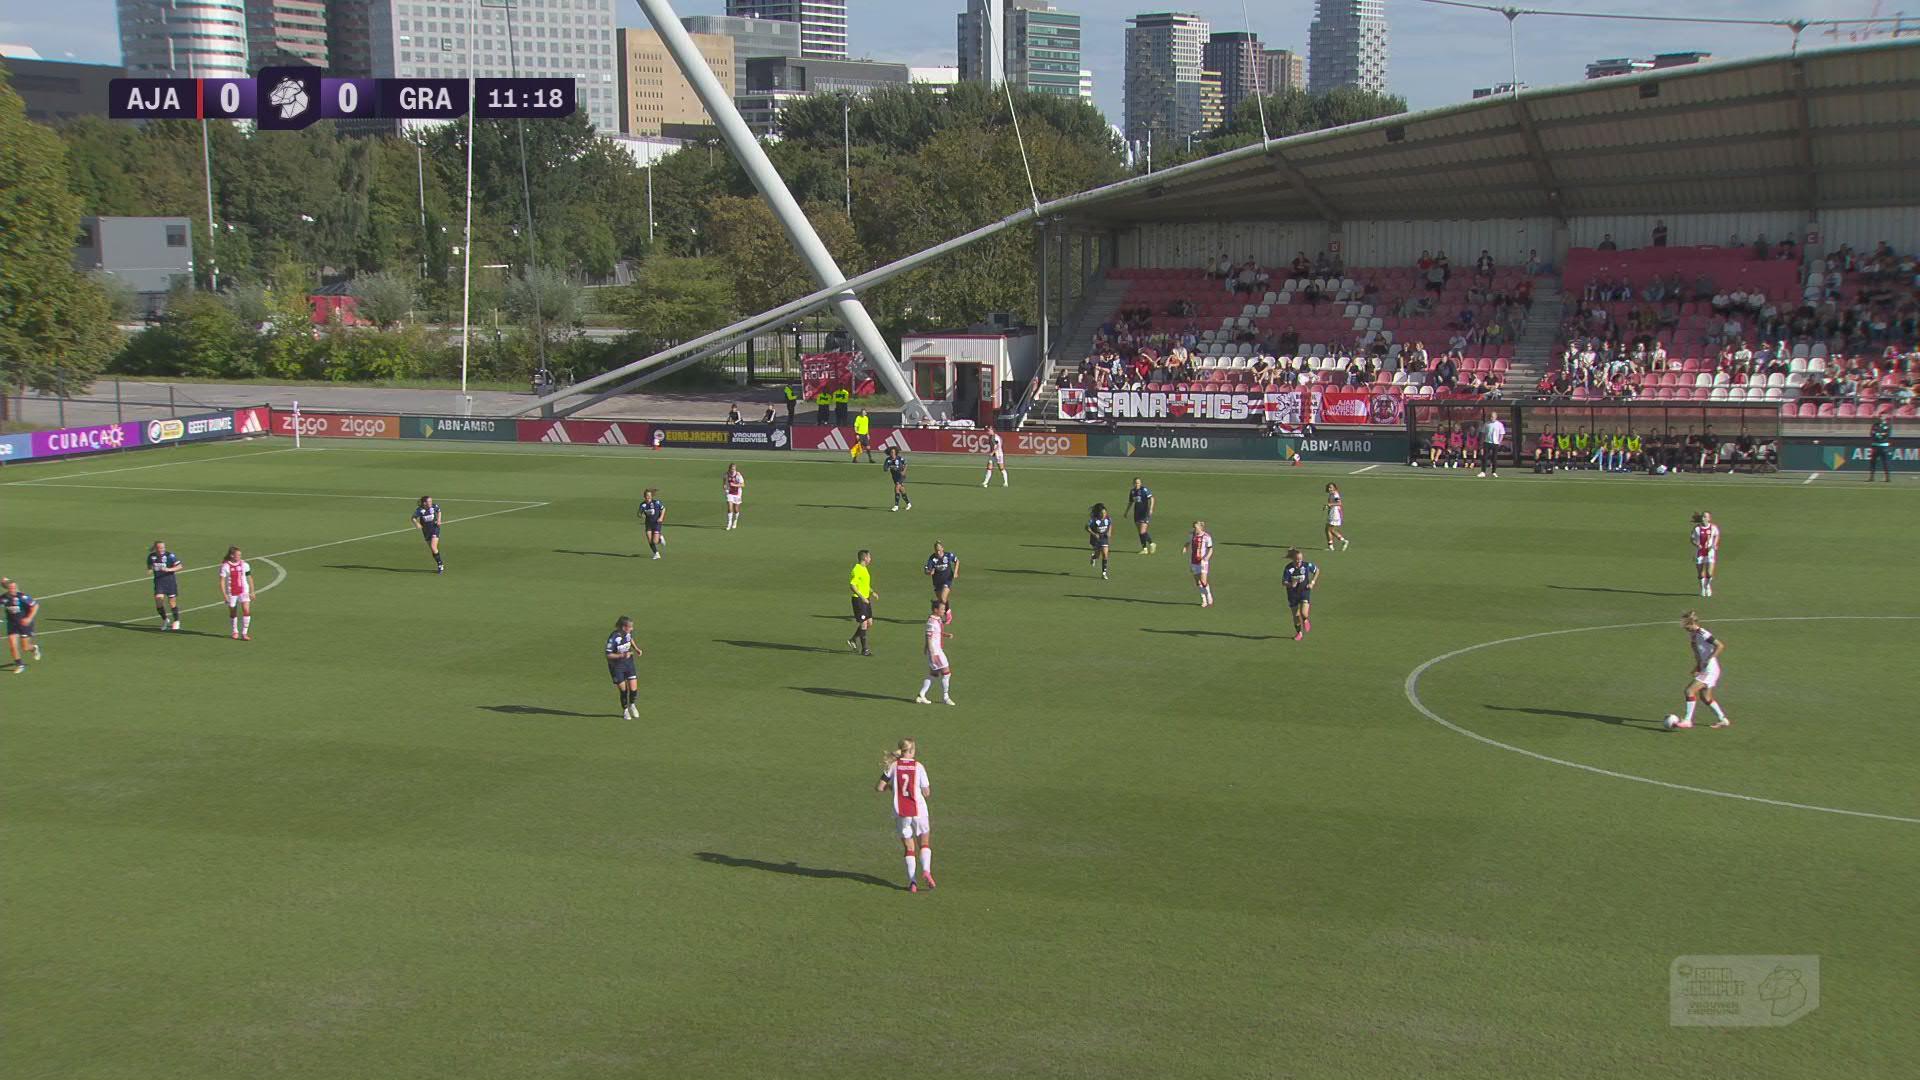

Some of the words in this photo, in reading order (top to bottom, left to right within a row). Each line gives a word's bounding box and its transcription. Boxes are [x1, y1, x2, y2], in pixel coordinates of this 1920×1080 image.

[804, 371, 836, 380] ROUTE
[340, 416, 385, 436] ziggo
[665, 431, 729, 443] EUROJACKPOT
[952, 431, 991, 453] zigg
[1018, 433, 1071, 454] ziggo
[901, 773, 910, 797] 2
